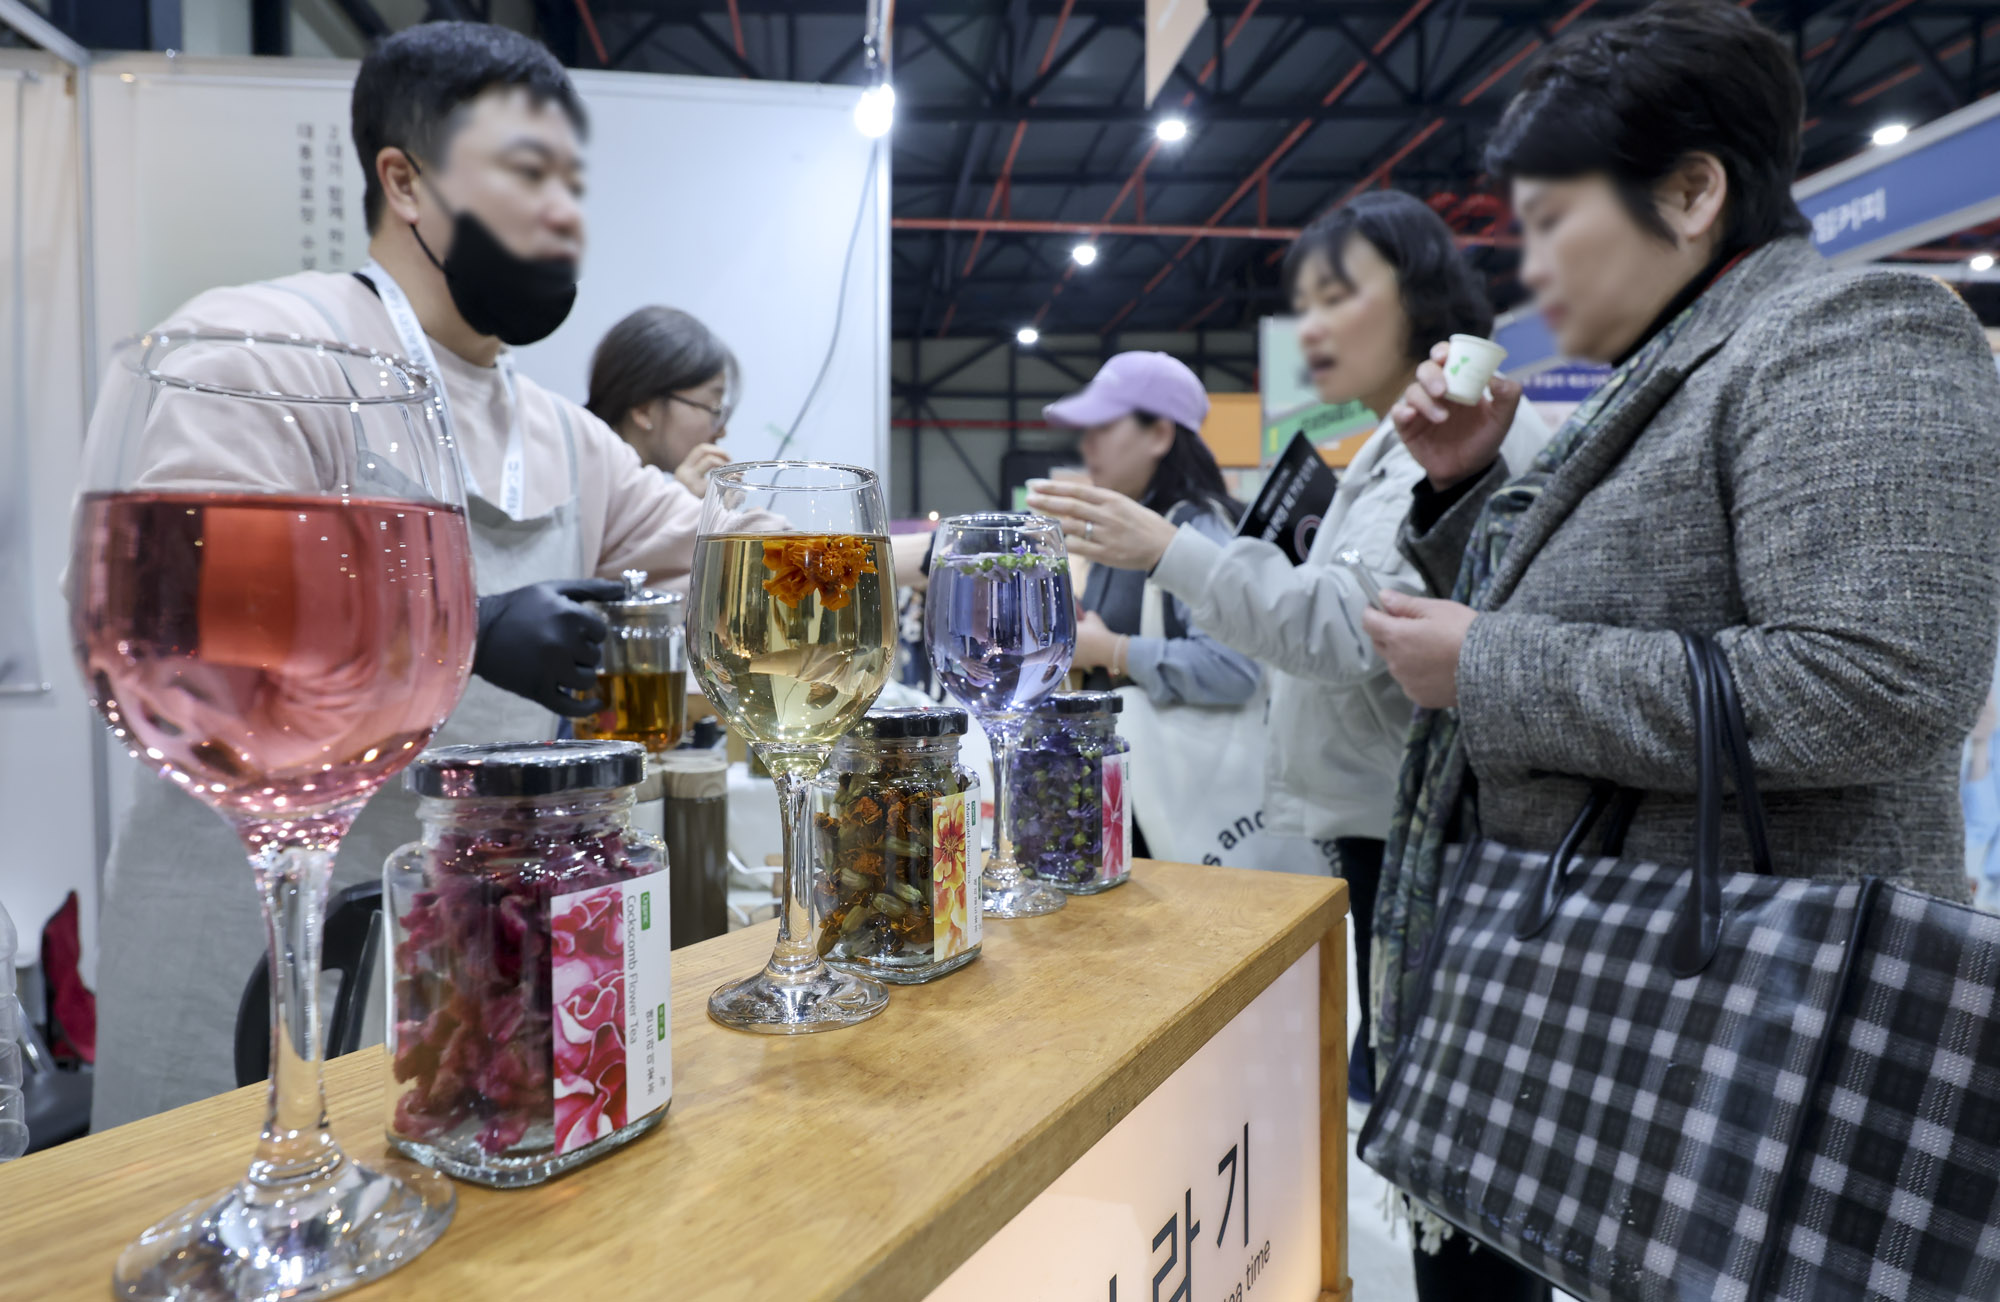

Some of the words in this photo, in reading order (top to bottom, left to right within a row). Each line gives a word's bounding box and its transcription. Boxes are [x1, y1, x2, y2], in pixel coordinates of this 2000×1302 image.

[626, 895, 638, 970] Cockscomb
[628, 973, 638, 1017] Flower
[630, 1019, 639, 1045] Tea
[1246, 1240, 1271, 1291] time
